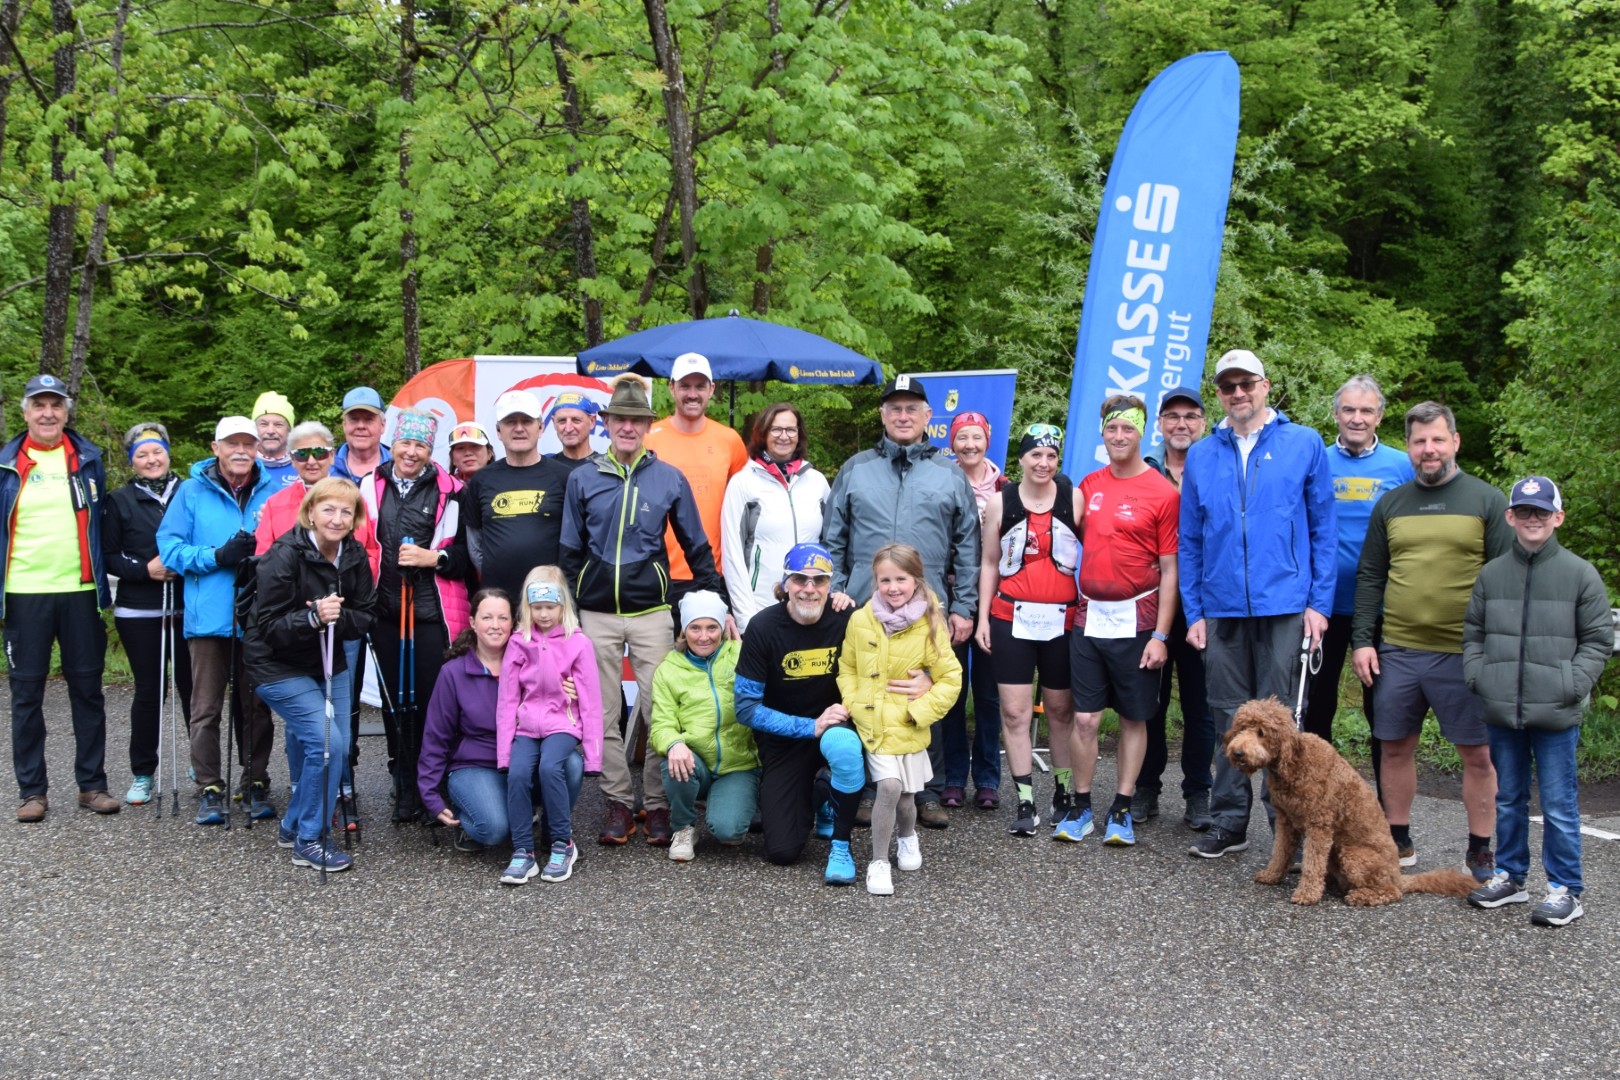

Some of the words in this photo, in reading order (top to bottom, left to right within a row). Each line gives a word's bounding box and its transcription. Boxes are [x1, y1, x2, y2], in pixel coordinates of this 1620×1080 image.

[1094, 239, 1171, 467] KASSE
[800, 369, 815, 377] Lions
[811, 660, 827, 668] RUN
